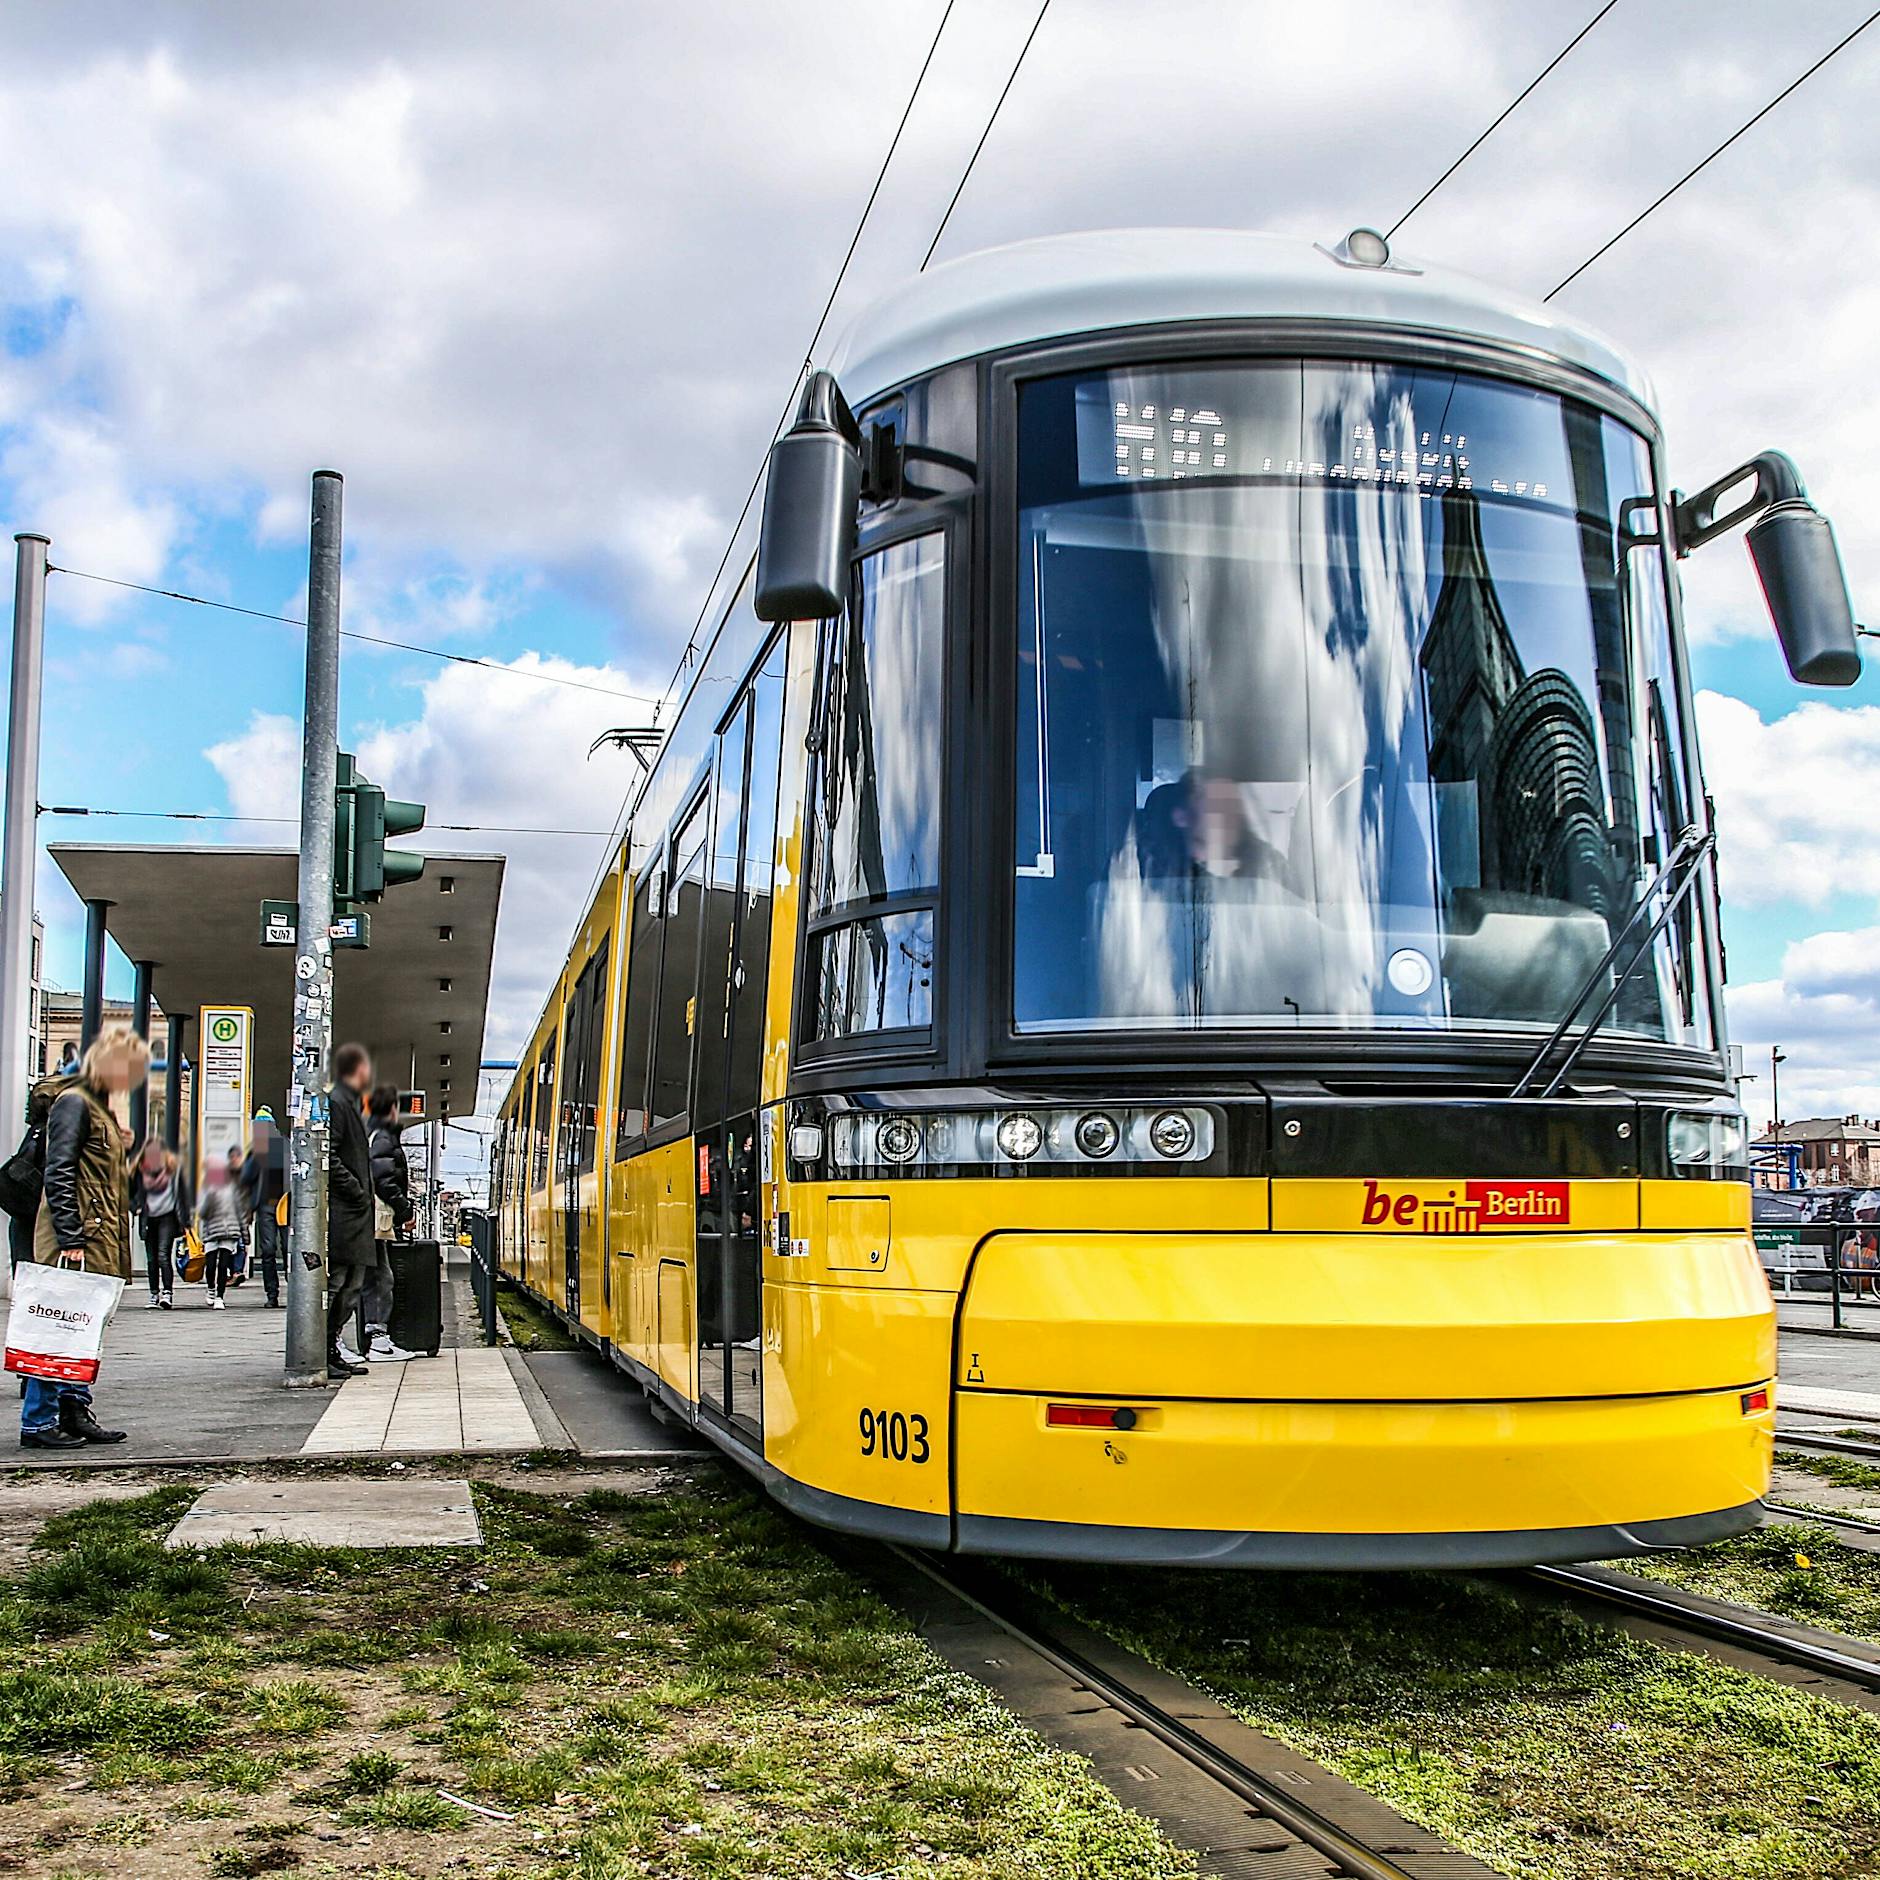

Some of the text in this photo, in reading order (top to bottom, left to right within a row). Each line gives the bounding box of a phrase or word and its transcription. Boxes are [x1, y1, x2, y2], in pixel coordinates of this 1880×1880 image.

[1486, 1190, 1561, 1216] Berlin
[28, 1304, 93, 1326] shoe city
[860, 1408, 929, 1464] 9103
